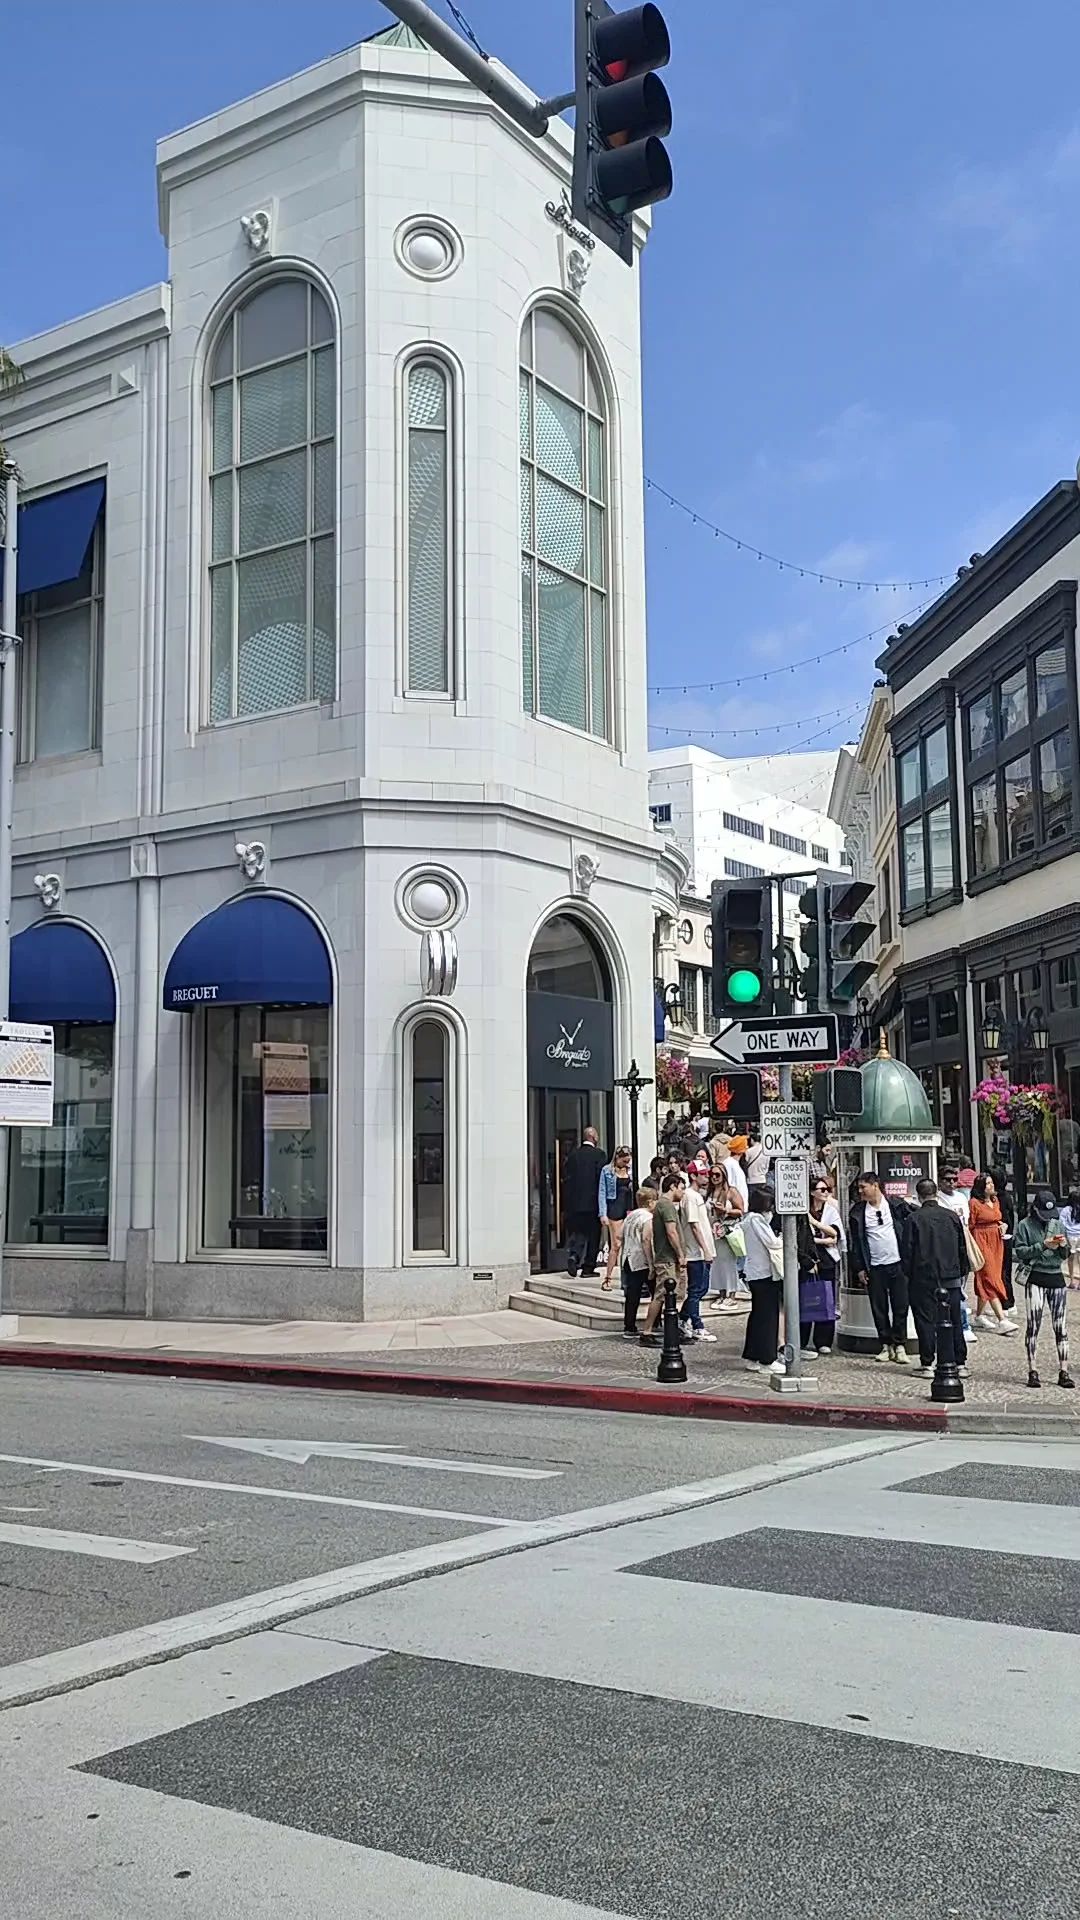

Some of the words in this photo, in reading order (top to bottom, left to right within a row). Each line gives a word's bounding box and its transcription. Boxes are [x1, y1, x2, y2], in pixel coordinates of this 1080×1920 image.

[172, 985, 219, 1001] BREGUET
[747, 1033, 780, 1050] ONE
[786, 1031, 819, 1048] WAY
[764, 1105, 811, 1115] DIAGONAL
[763, 1117, 813, 1127] CROSSING
[764, 1134, 783, 1151] OK
[780, 1163, 804, 1171] CROSS
[888, 1167, 923, 1177] TUDOR
[782, 1173, 802, 1181] ONLY
[787, 1182, 798, 1190] ON
[783, 1191, 803, 1199] WALK
[780, 1200, 806, 1208] SIGNAL
